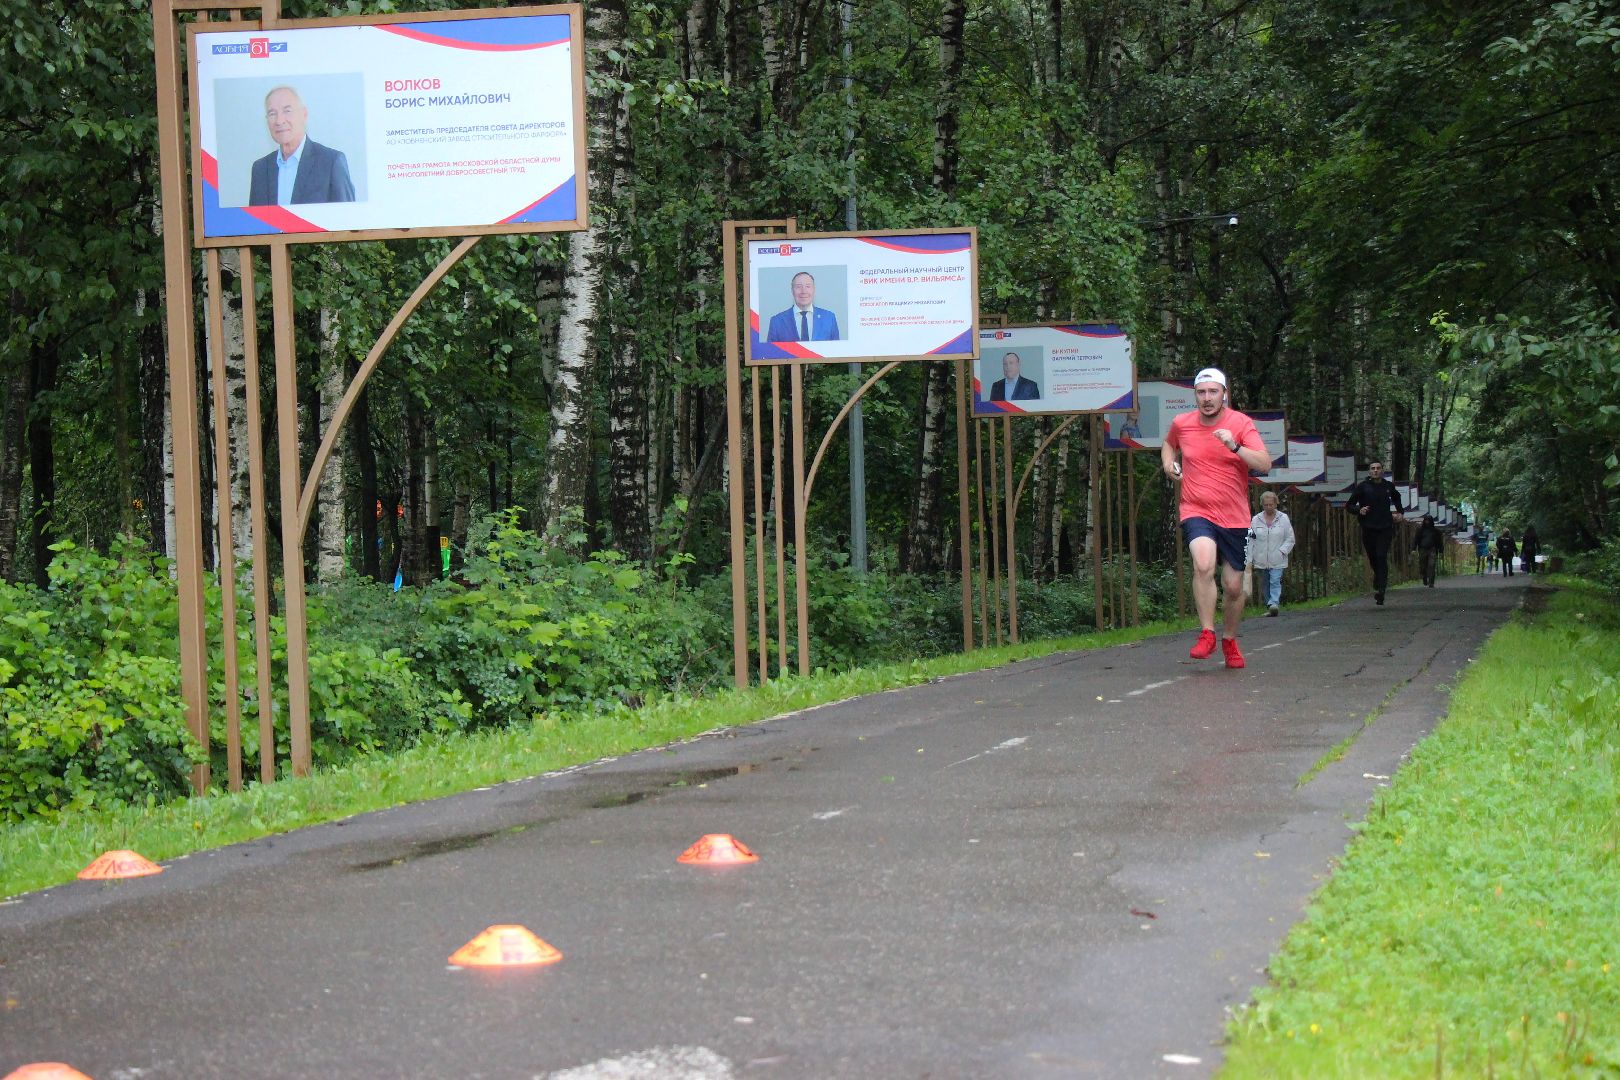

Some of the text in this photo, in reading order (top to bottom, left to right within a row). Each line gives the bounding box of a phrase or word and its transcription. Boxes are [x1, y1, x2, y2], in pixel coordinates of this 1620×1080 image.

[251, 41, 268, 55] 61
[384, 78, 441, 92] ВОЛКОВ
[385, 92, 512, 109] БОРИС МИХАЙЛОВИЧ
[385, 120, 566, 137] ЗАМЕСТИТЕЛЬ ПРЕДСЕДАТЕЛЯ СОВЕТА ДИРЕКТОРОВ
[447, 133, 471, 143] ЗАВОД
[471, 131, 530, 142] СТРОИТЕЛЬНОГО
[422, 160, 451, 169] ГРАМОТА
[452, 158, 499, 168] МОСКОВСКОЙ
[499, 156, 540, 166] ОБЛАСТНОЙ
[540, 156, 561, 164] ДУМЫ
[397, 169, 445, 179] МНОГОЛЕТНИЙ
[509, 166, 526, 174] ТРУД
[859, 265, 965, 276] ФЕДЕРАЛЬНЫЙ НАУЧНЫЙ ЦЕНТР
[880, 276, 906, 284] ИМЕНИ
